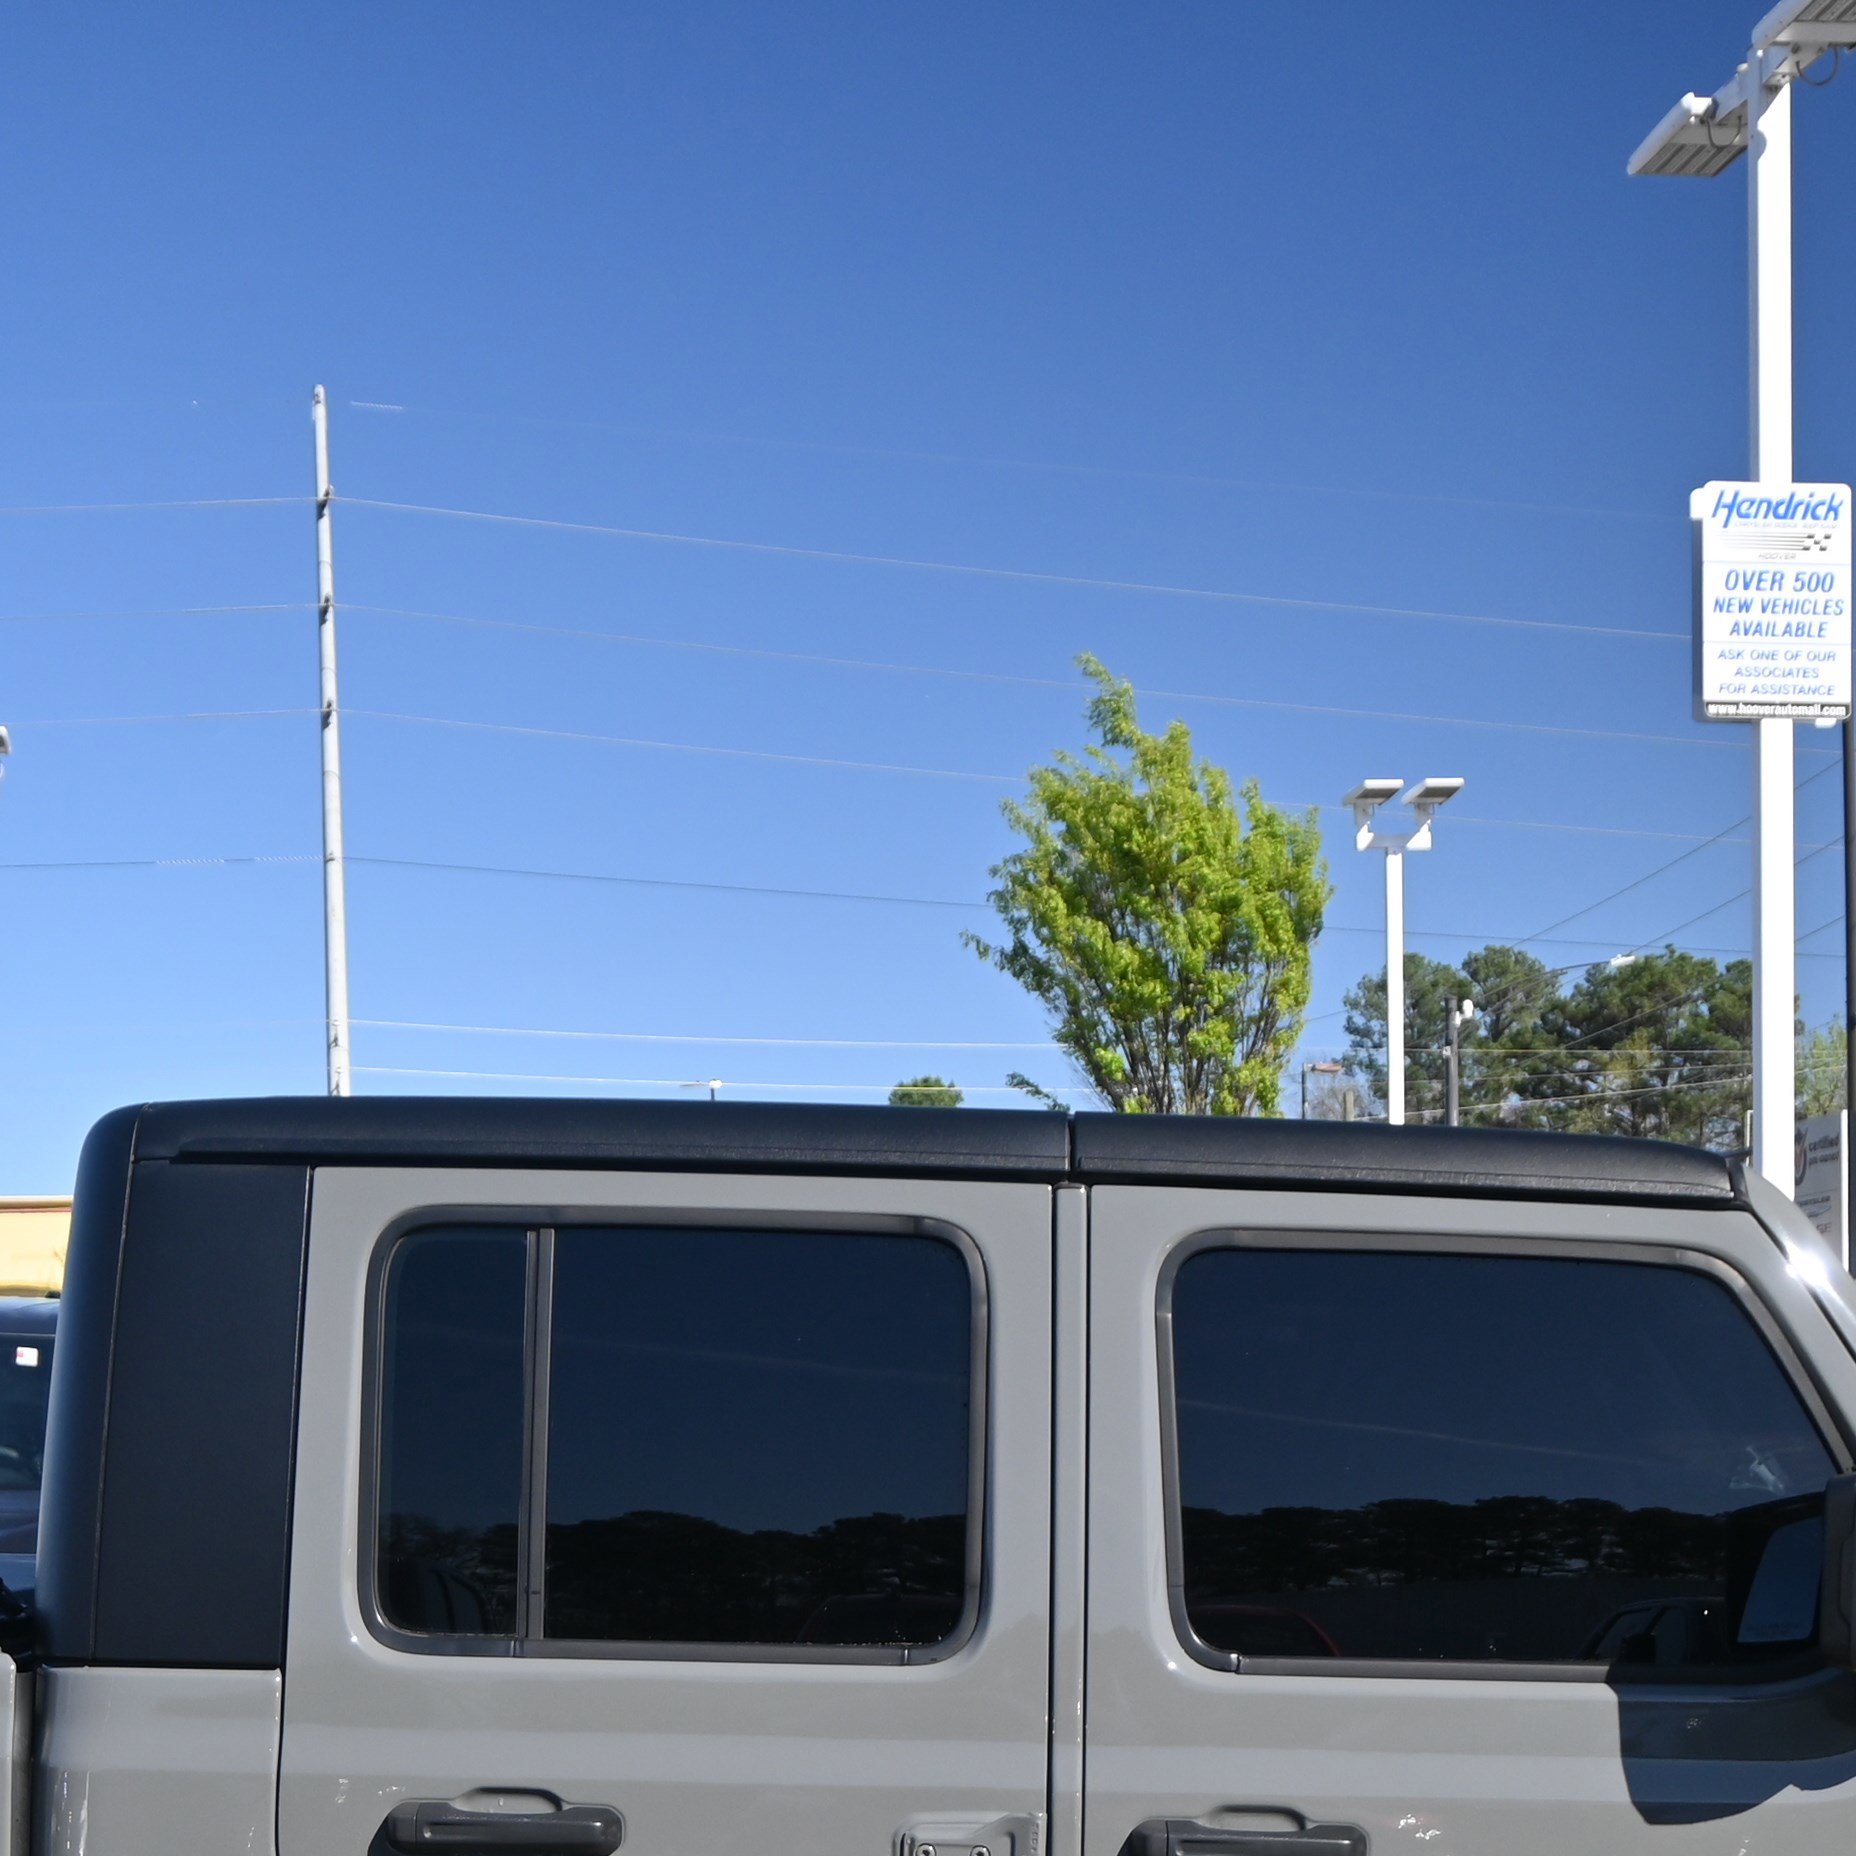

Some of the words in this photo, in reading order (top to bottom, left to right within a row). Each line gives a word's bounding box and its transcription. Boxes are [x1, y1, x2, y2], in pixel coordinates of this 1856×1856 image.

[1711, 489, 1844, 528] Hendrick
[1725, 569, 1785, 591] OVER
[1794, 571, 1834, 592] 500
[1713, 597, 1754, 613] NEW
[1761, 598, 1844, 616] VEHICLES
[1729, 620, 1828, 638] AVAILABLE
[1718, 649, 1745, 660] ASK
[1750, 650, 1778, 661] ONE
[1784, 650, 1803, 661] OF
[1807, 650, 1836, 662] OUR
[1734, 667, 1820, 678] ASSOCIATES
[1719, 683, 1746, 694] FOR
[1751, 684, 1835, 696] ASSISTANCE
